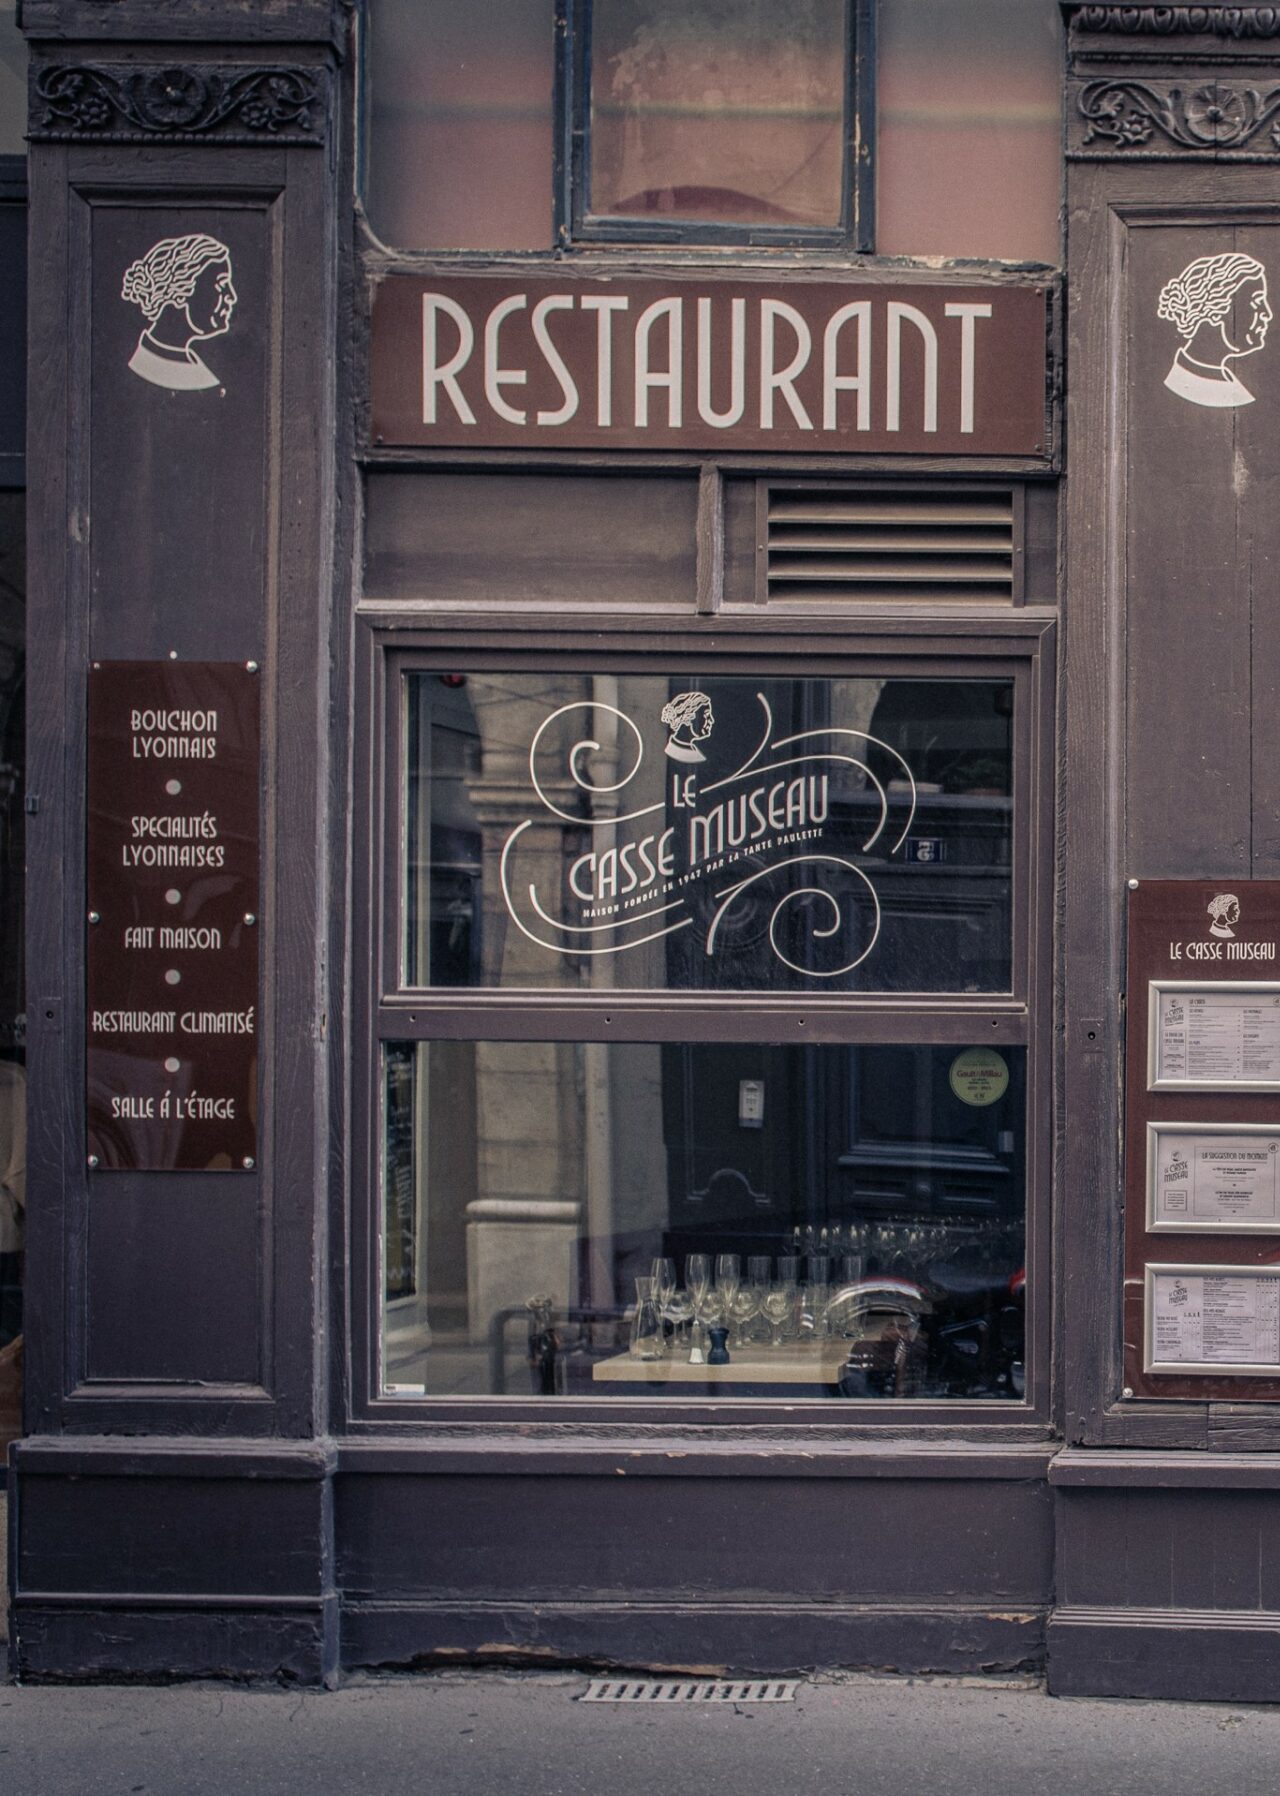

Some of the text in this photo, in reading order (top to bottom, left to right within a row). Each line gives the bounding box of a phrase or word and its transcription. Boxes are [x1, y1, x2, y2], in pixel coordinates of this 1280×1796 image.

[422, 293, 993, 434] RESTAURANT
[131, 709, 217, 732] BOUCHON
[133, 736, 216, 759] LYONNAIS
[673, 774, 696, 808] LE
[131, 810, 217, 838] SPECIALITÉS
[569, 775, 828, 902] CASSE MUSEAU
[122, 844, 224, 867] LYONNAISES
[583, 828, 823, 918] MAISON FONDÉE EN 1947 PAR LA TANTE PAULETTE
[125, 927, 221, 949] FAIT MAISON
[1170, 942, 1276, 960] LE CASSE MUSEAU
[92, 1006, 254, 1034] RESTAURANT CLIMATISÉ
[111, 1097, 154, 1118] SALLE
[176, 1090, 235, 1119] L'ÉTAGE
